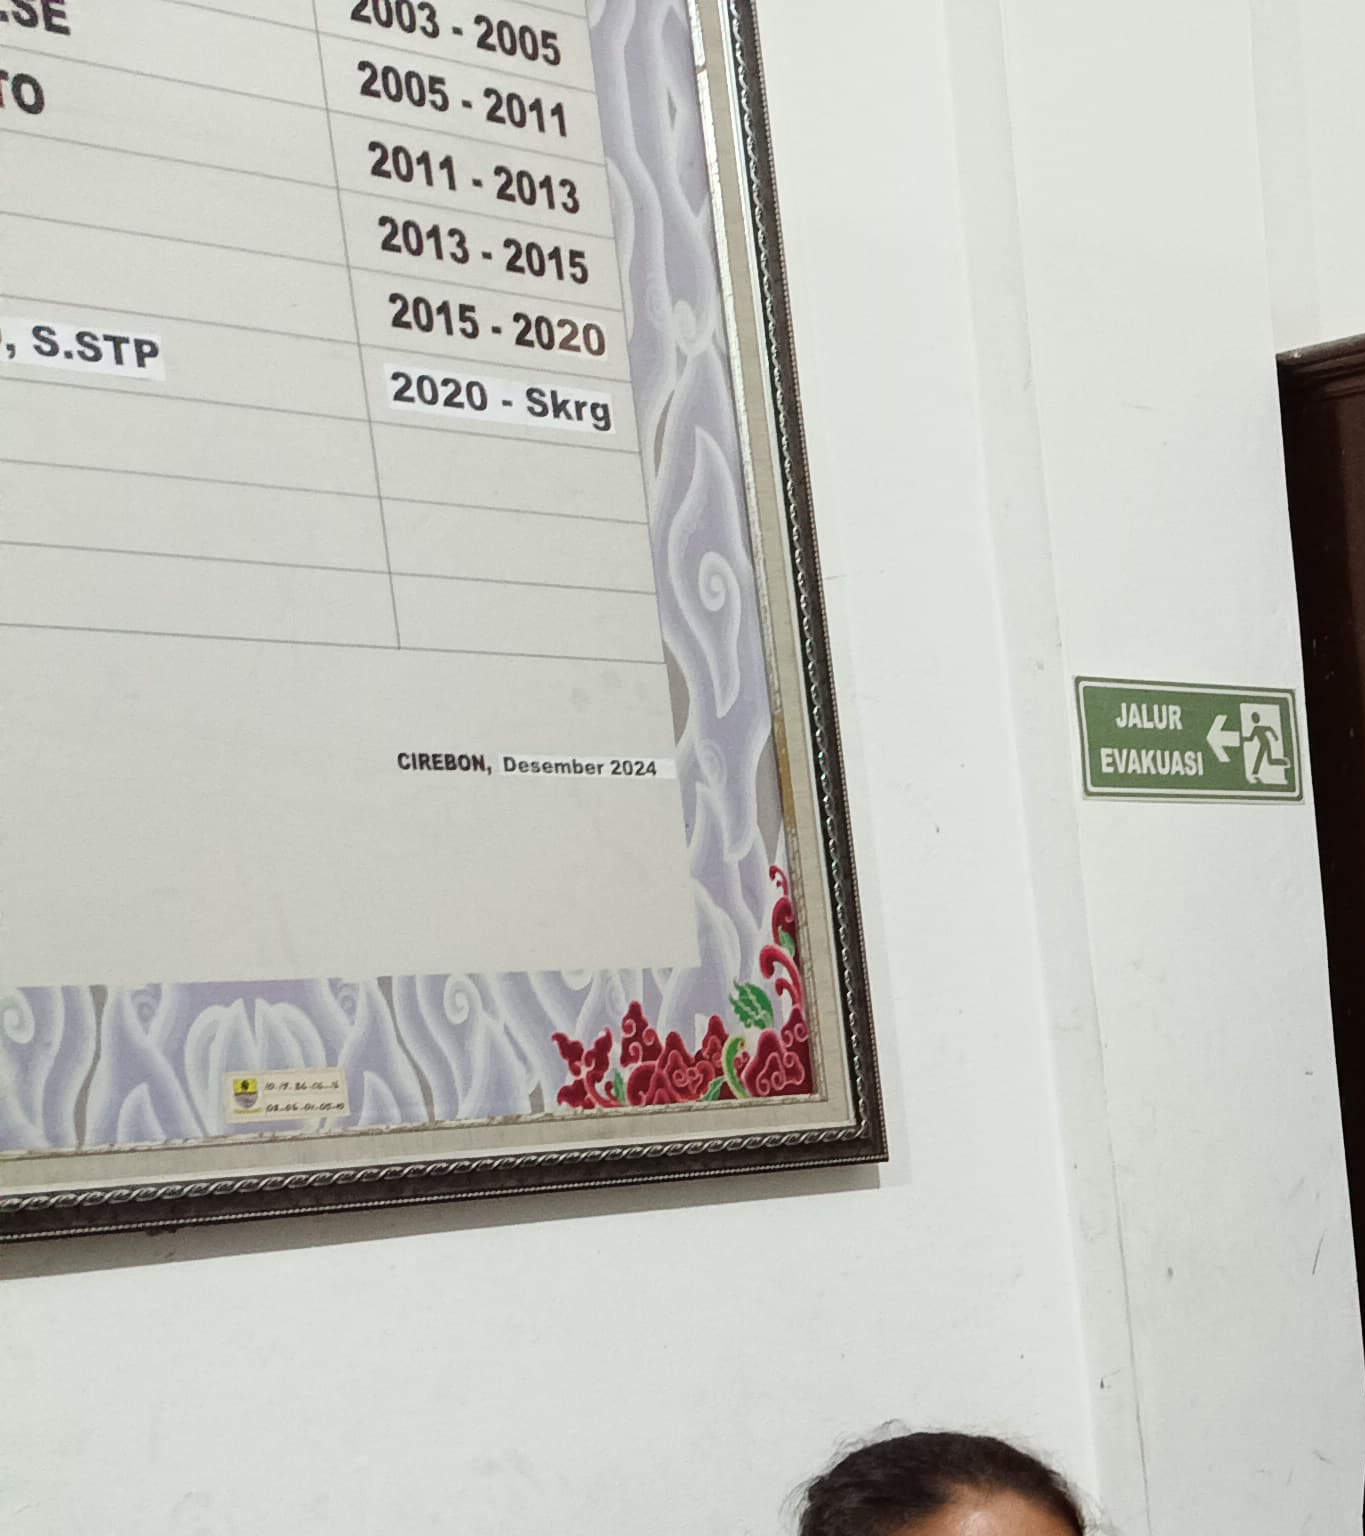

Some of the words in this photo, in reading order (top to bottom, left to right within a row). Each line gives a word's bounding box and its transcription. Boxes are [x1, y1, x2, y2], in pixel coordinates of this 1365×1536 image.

[0, 0, 71, 36] SE
[350, 0, 440, 38] 2003
[473, 14, 562, 66] 2005
[357, 60, 450, 112] 2005
[483, 87, 568, 137] 2011
[368, 141, 457, 191] 2011
[493, 165, 580, 214] 2013
[378, 216, 470, 264] 2013
[503, 237, 589, 285] 2015
[32, 325, 160, 368] S.STP
[388, 292, 480, 339] 2015
[512, 311, 606, 356] 2020
[390, 371, 488, 411] 2020
[525, 387, 613, 432] Skrg
[1115, 702, 1183, 730] JALUR
[397, 752, 492, 775] CIREBON,
[503, 756, 604, 776] Desember
[610, 759, 657, 776] 2024
[1100, 747, 1204, 776] EVAKUASI
